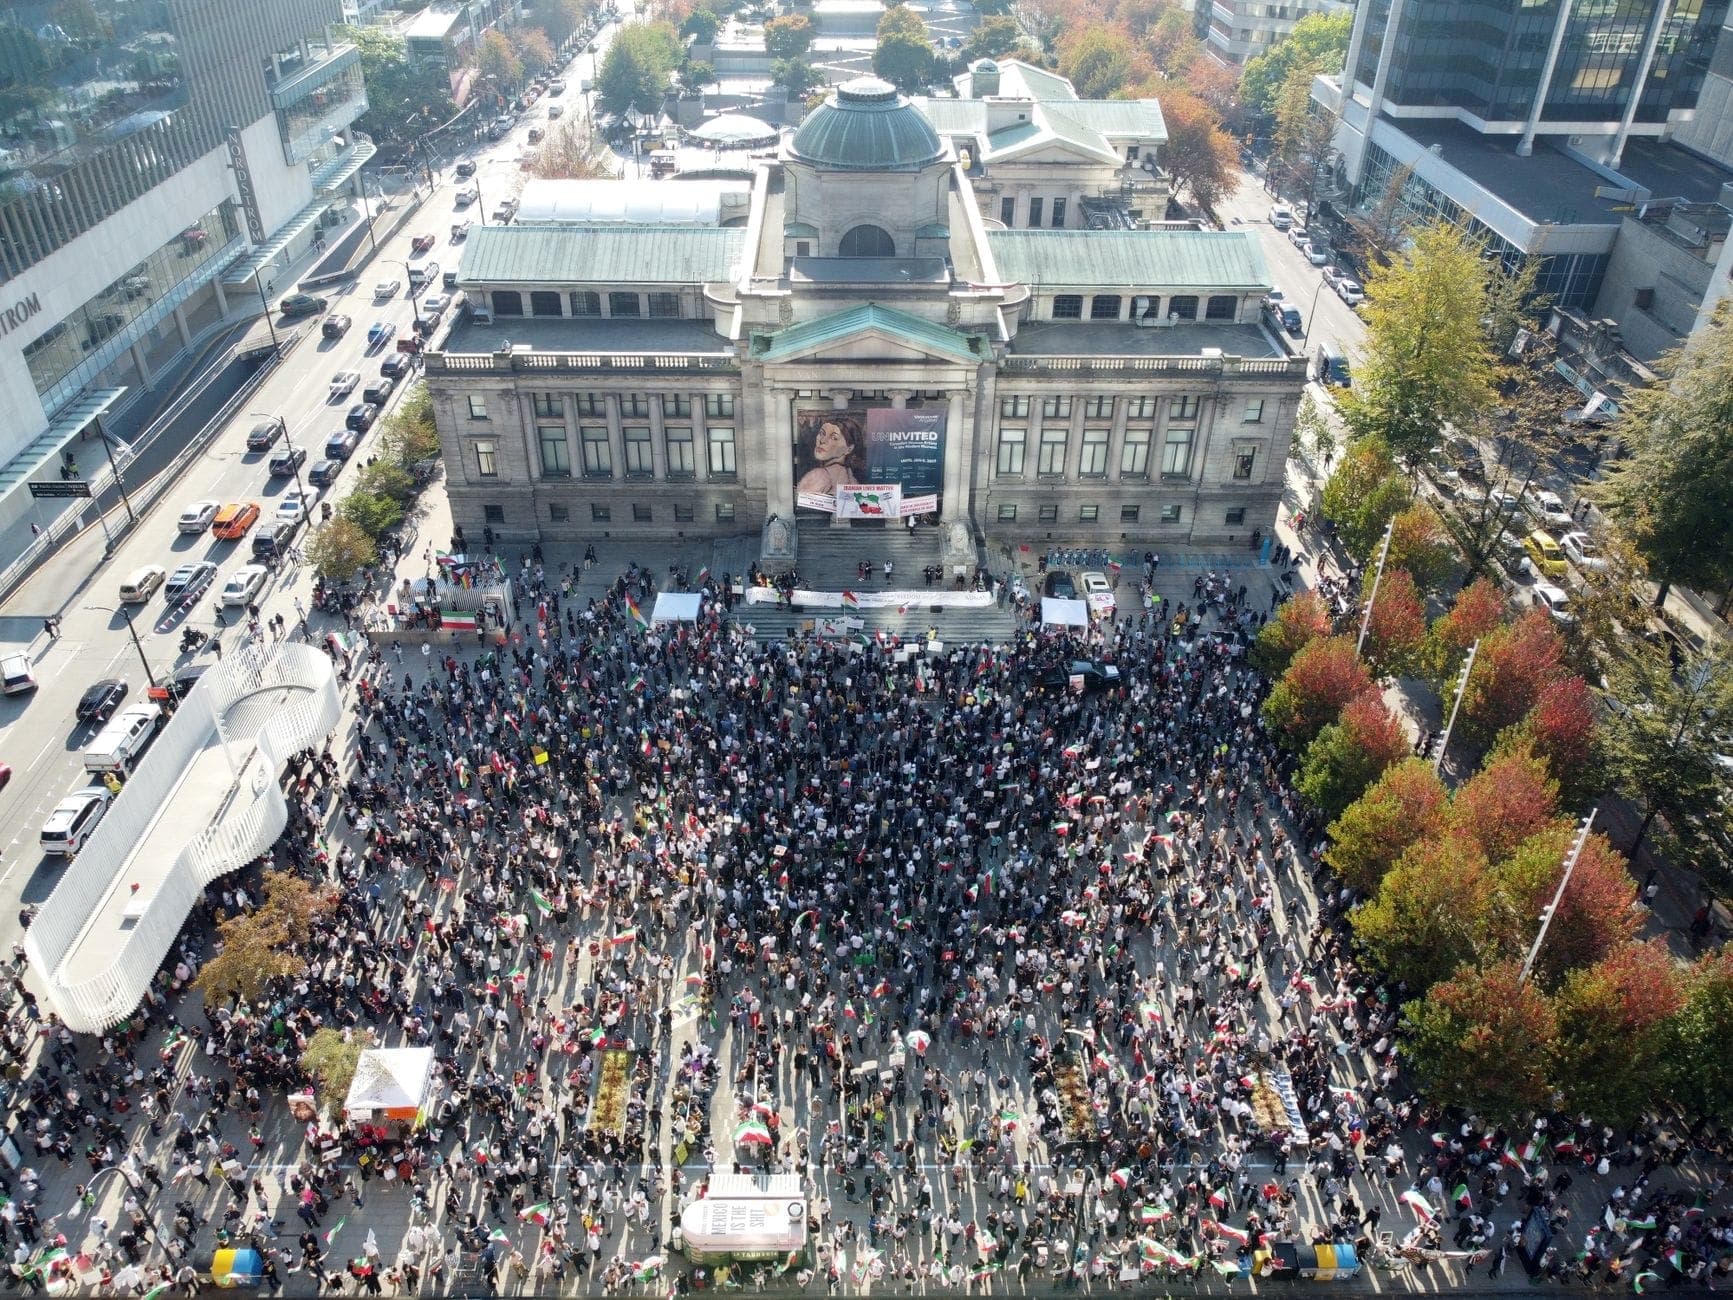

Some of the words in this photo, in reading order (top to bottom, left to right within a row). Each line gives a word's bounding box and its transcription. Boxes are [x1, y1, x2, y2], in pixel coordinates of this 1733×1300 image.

[227, 132, 262, 241] NORDSTROM
[871, 431, 938, 442] UNINVITED
[711, 1203, 728, 1235] MEXICO
[731, 1205, 747, 1221] THE
[749, 1208, 765, 1228] SHIT
[730, 1222, 746, 1231] IS
